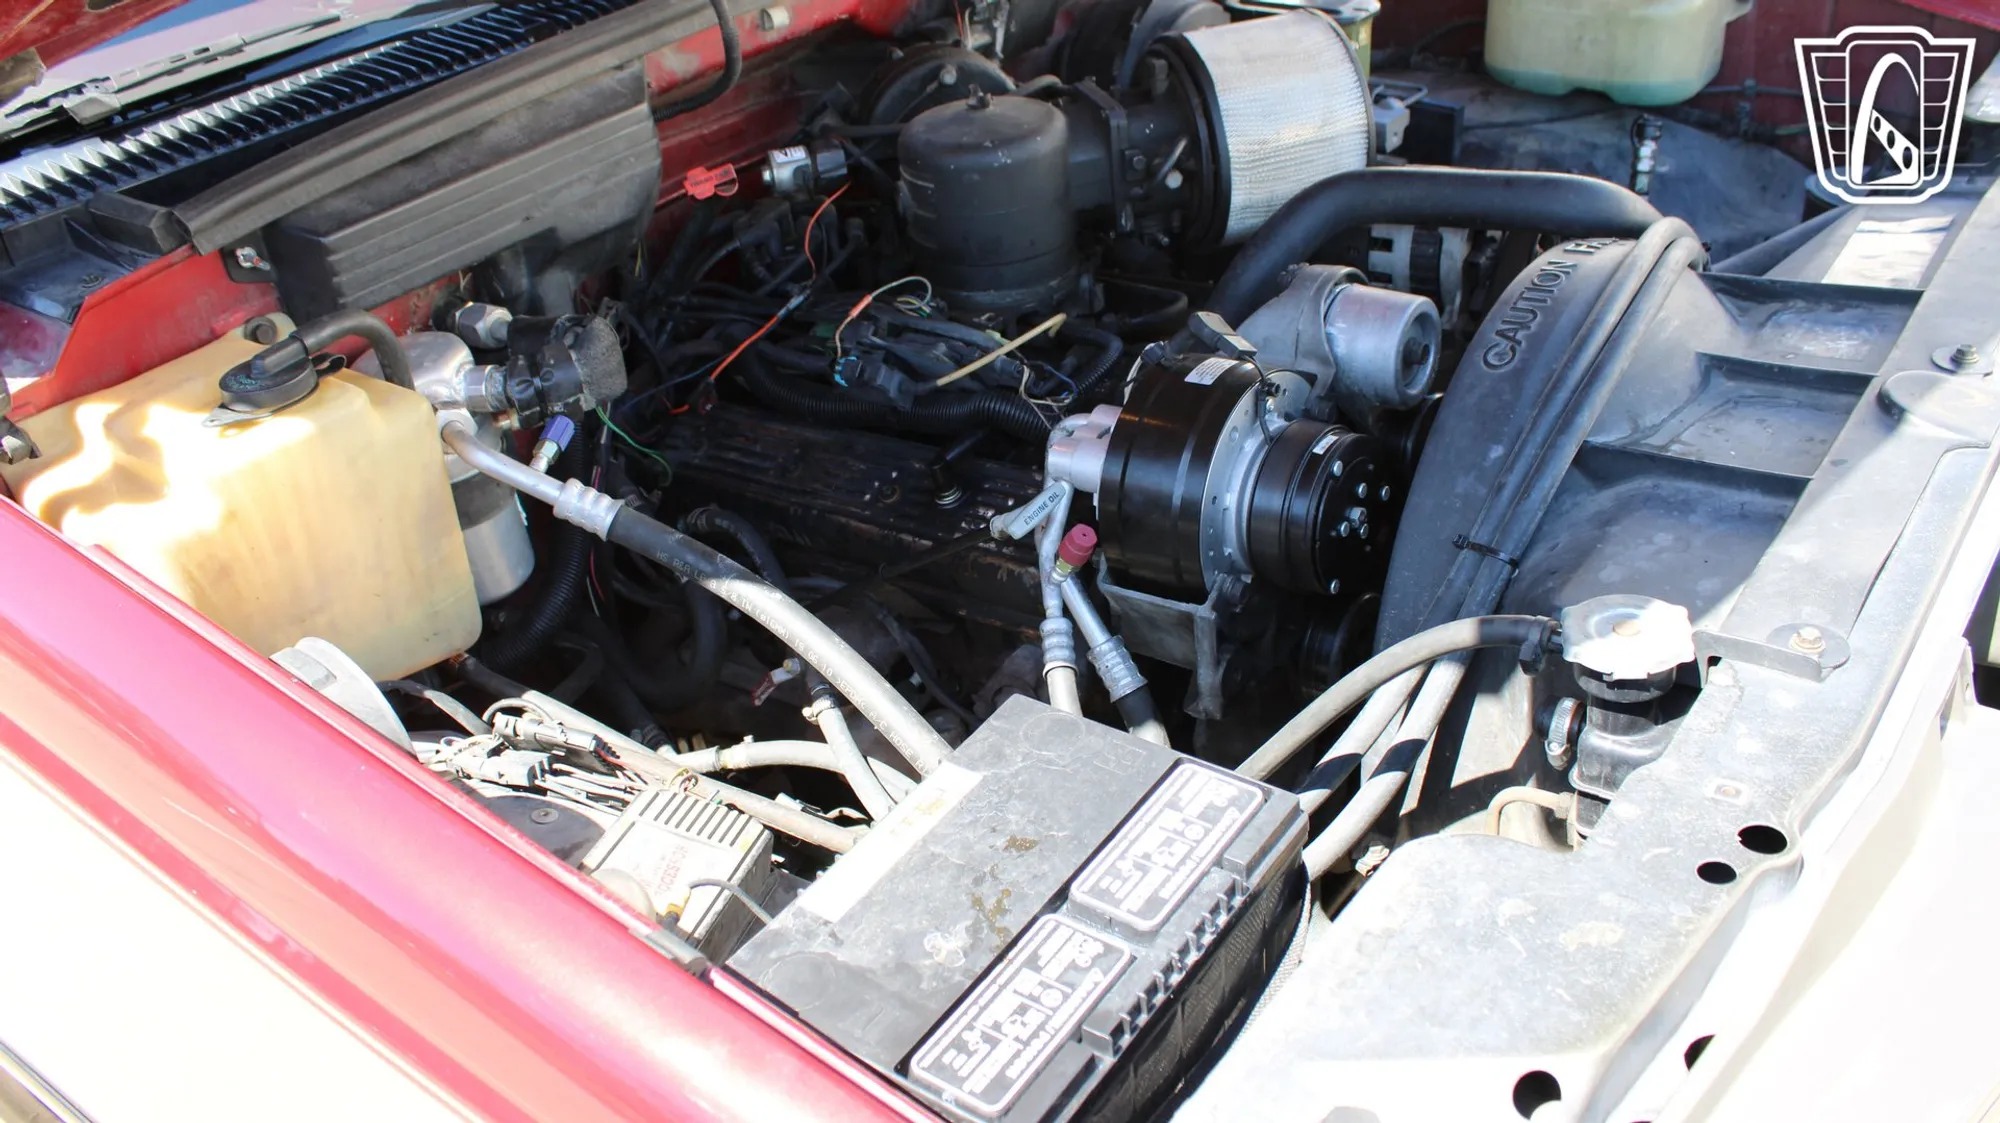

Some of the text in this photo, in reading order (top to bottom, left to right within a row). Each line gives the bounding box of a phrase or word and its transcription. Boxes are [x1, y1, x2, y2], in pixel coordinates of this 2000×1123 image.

[1482, 259, 1577, 370] CAUTION
[1024, 492, 1059, 525] ENGINE OIL
[889, 731, 914, 759] HOSE
